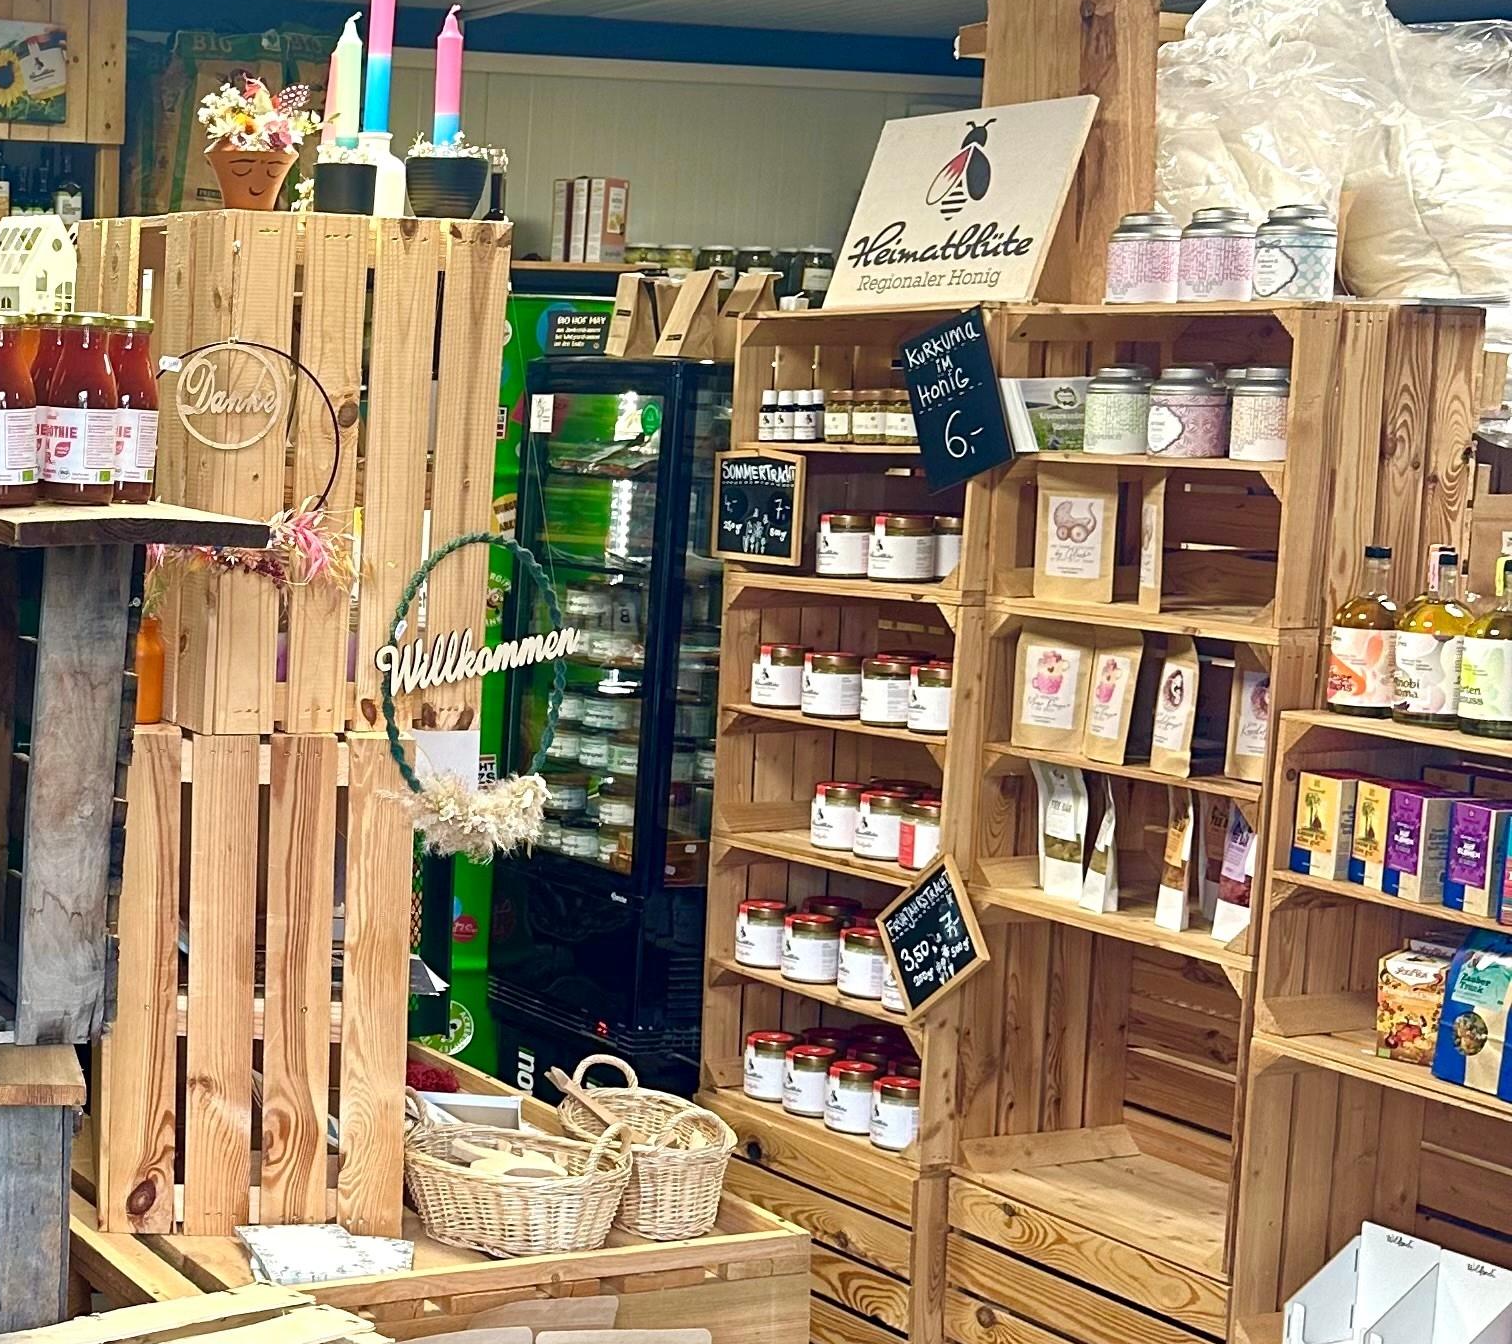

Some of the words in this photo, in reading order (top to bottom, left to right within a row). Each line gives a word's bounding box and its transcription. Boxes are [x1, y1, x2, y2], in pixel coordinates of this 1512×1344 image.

[848, 220, 1035, 268] Heimatblüte
[856, 270, 946, 295] Regionaler
[948, 267, 1002, 291] Honig
[182, 363, 276, 415] Danke
[376, 626, 582, 698] Willkommen
